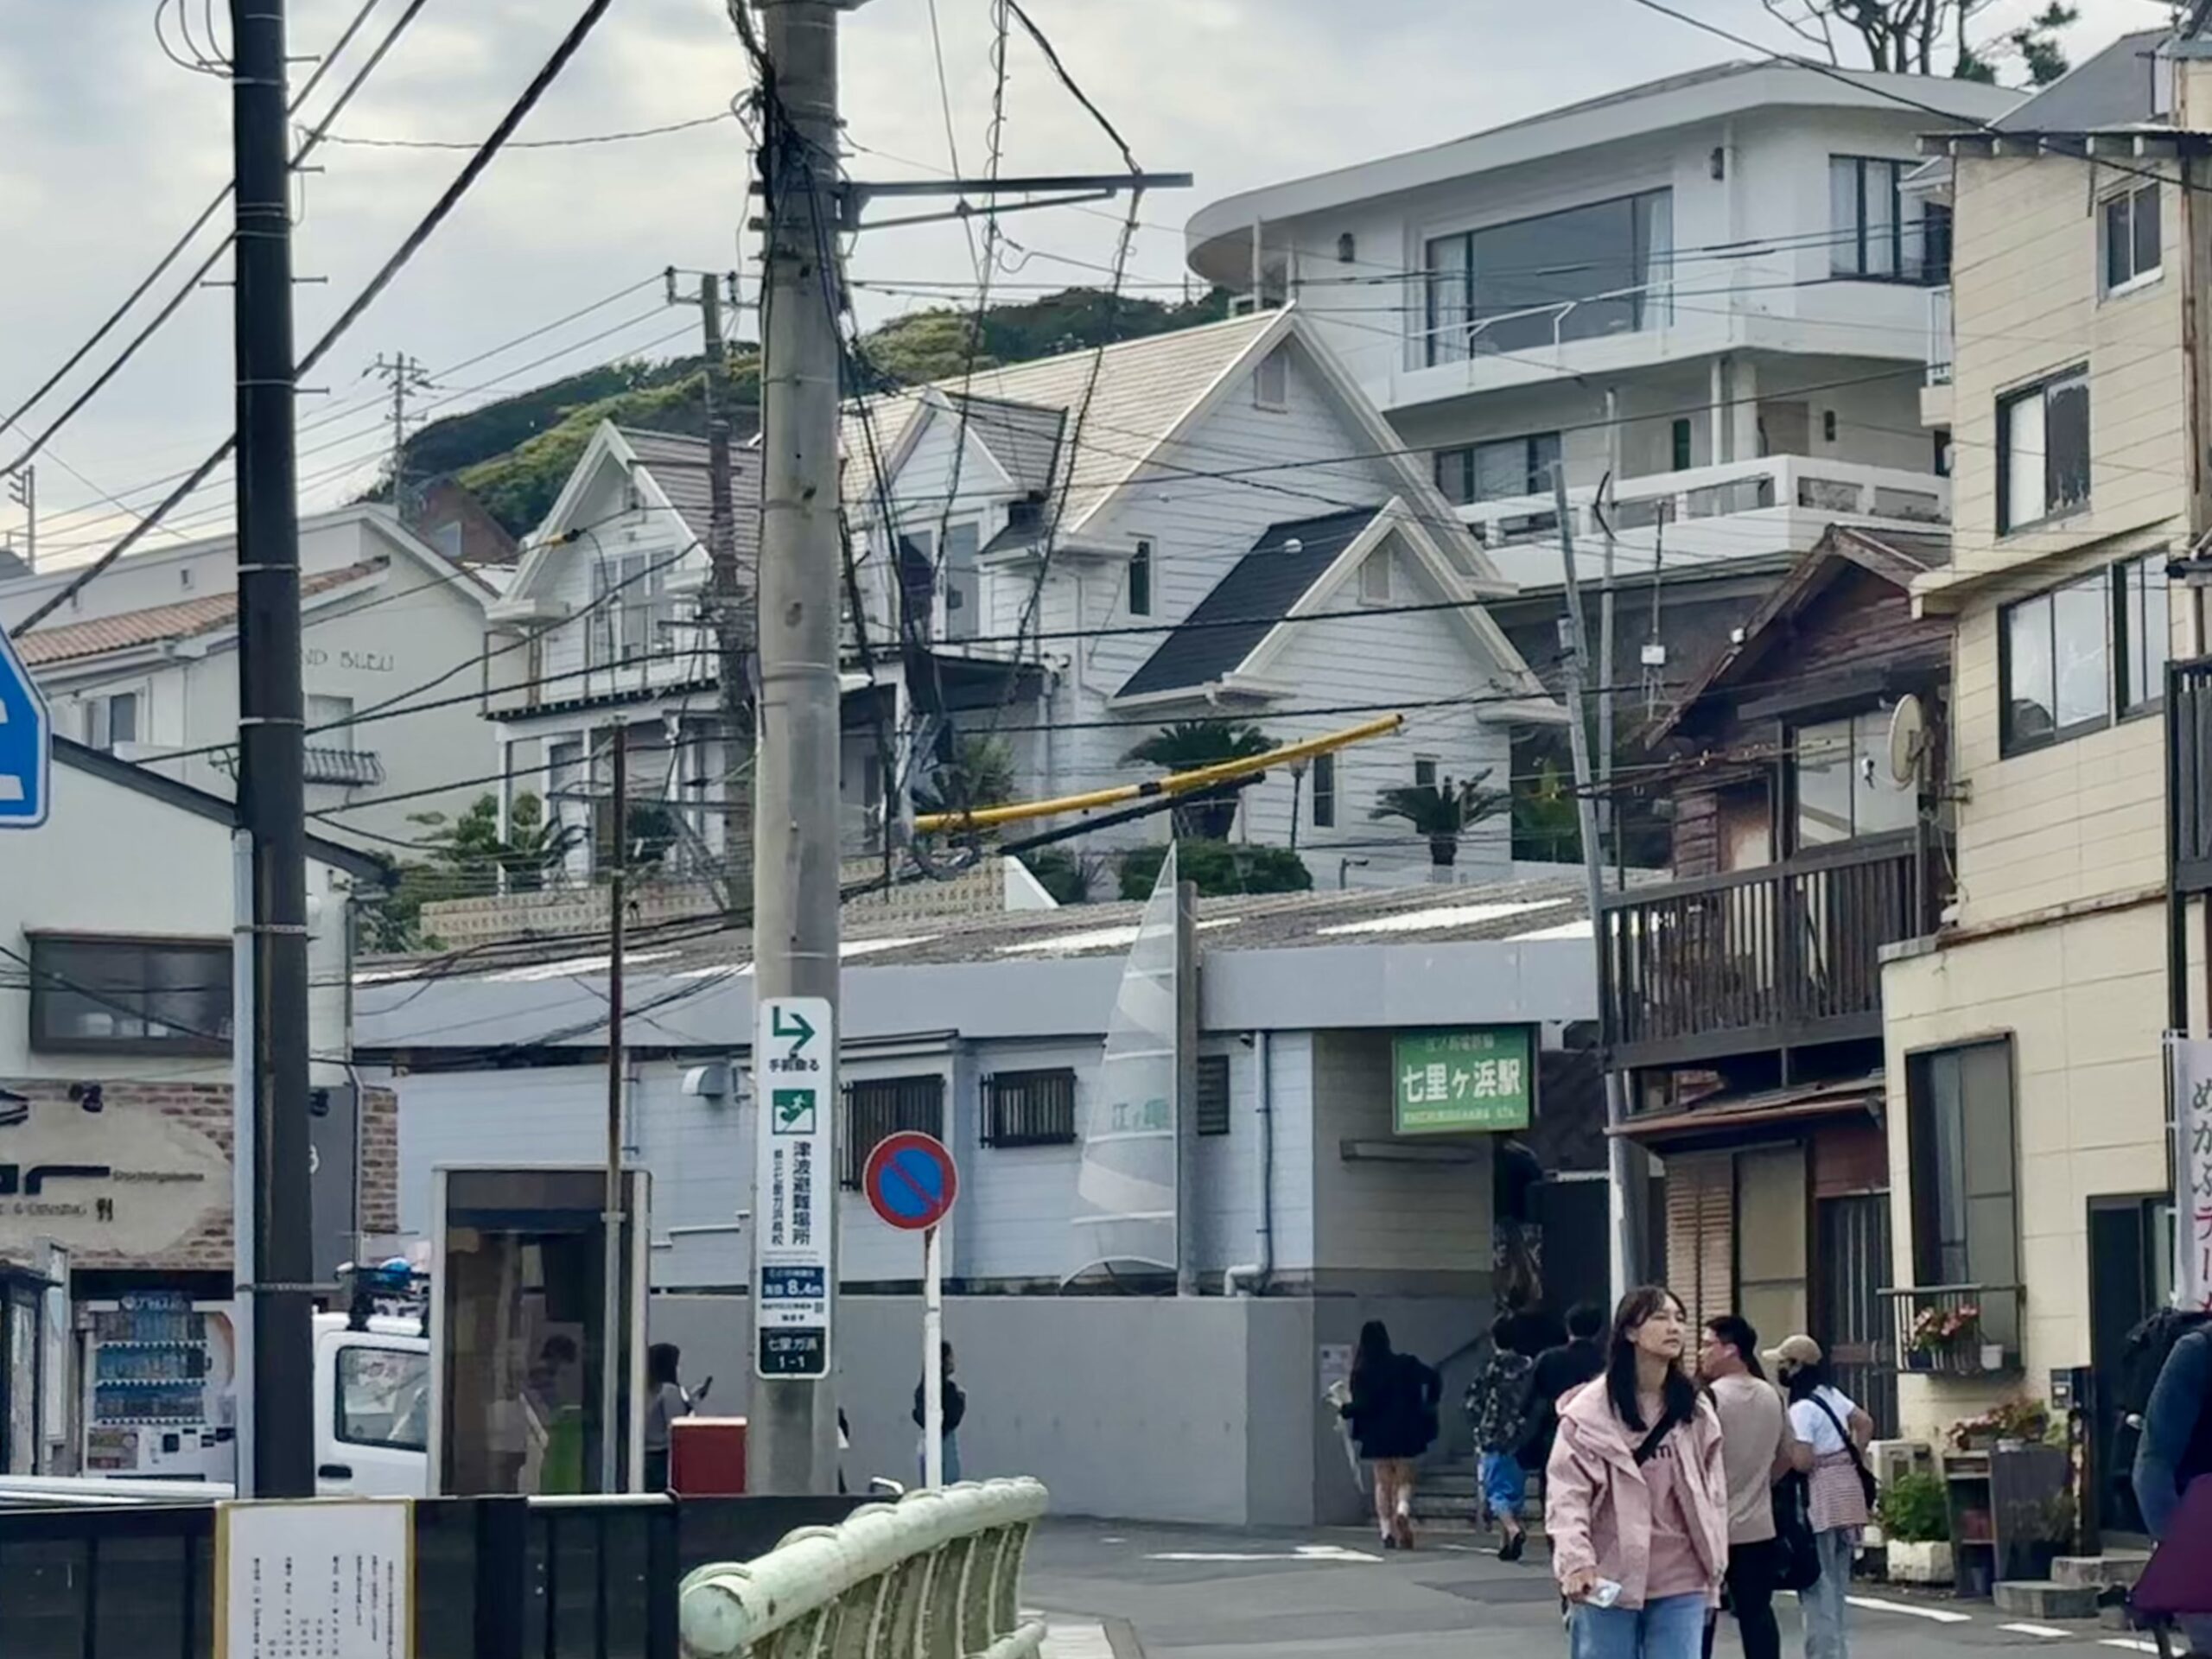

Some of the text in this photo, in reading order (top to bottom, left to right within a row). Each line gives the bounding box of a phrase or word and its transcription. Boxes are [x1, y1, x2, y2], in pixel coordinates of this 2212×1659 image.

[792, 1141, 810, 1245] 津波避難場所
[787, 1279, 823, 1295] 8.4m
[779, 1355, 805, 1369] 1-1
